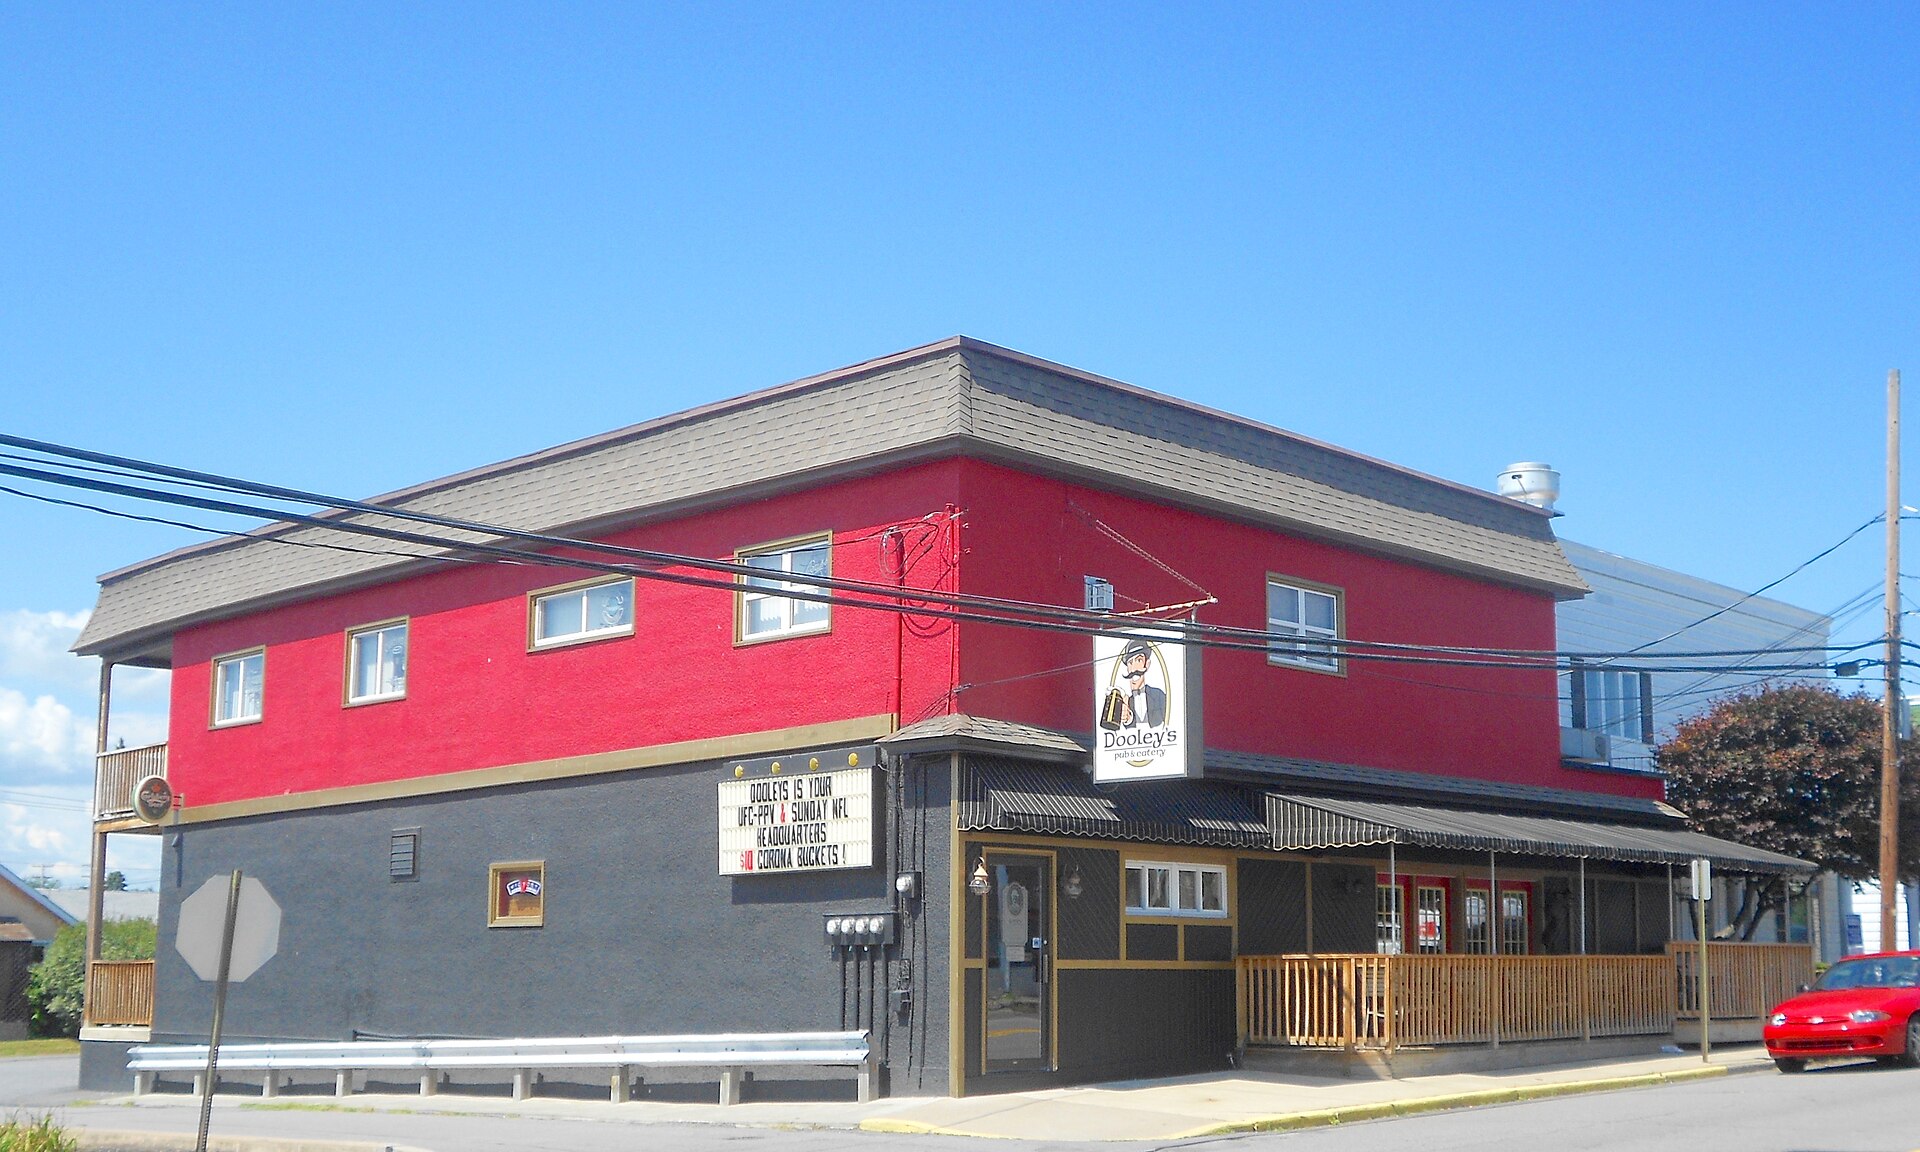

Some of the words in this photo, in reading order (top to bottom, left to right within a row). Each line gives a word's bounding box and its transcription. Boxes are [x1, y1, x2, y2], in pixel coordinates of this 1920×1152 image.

[1104, 727, 1177, 748] Dooley's
[1114, 751, 1129, 761] pub
[1136, 749, 1166, 758] eatery
[750, 780, 789, 803] DOOLEYS
[794, 779, 803, 799] IS
[808, 776, 832, 799] YOUR
[738, 804, 775, 826] UFC-PPV
[780, 803, 786, 823] &
[791, 799, 828, 822] SUNDAY
[832, 797, 848, 819] NFL
[757, 822, 827, 847] HEADQUARTERS
[739, 850, 753, 871] $10
[757, 848, 793, 870] CORONA
[797, 844, 838, 867] BUCKETS
